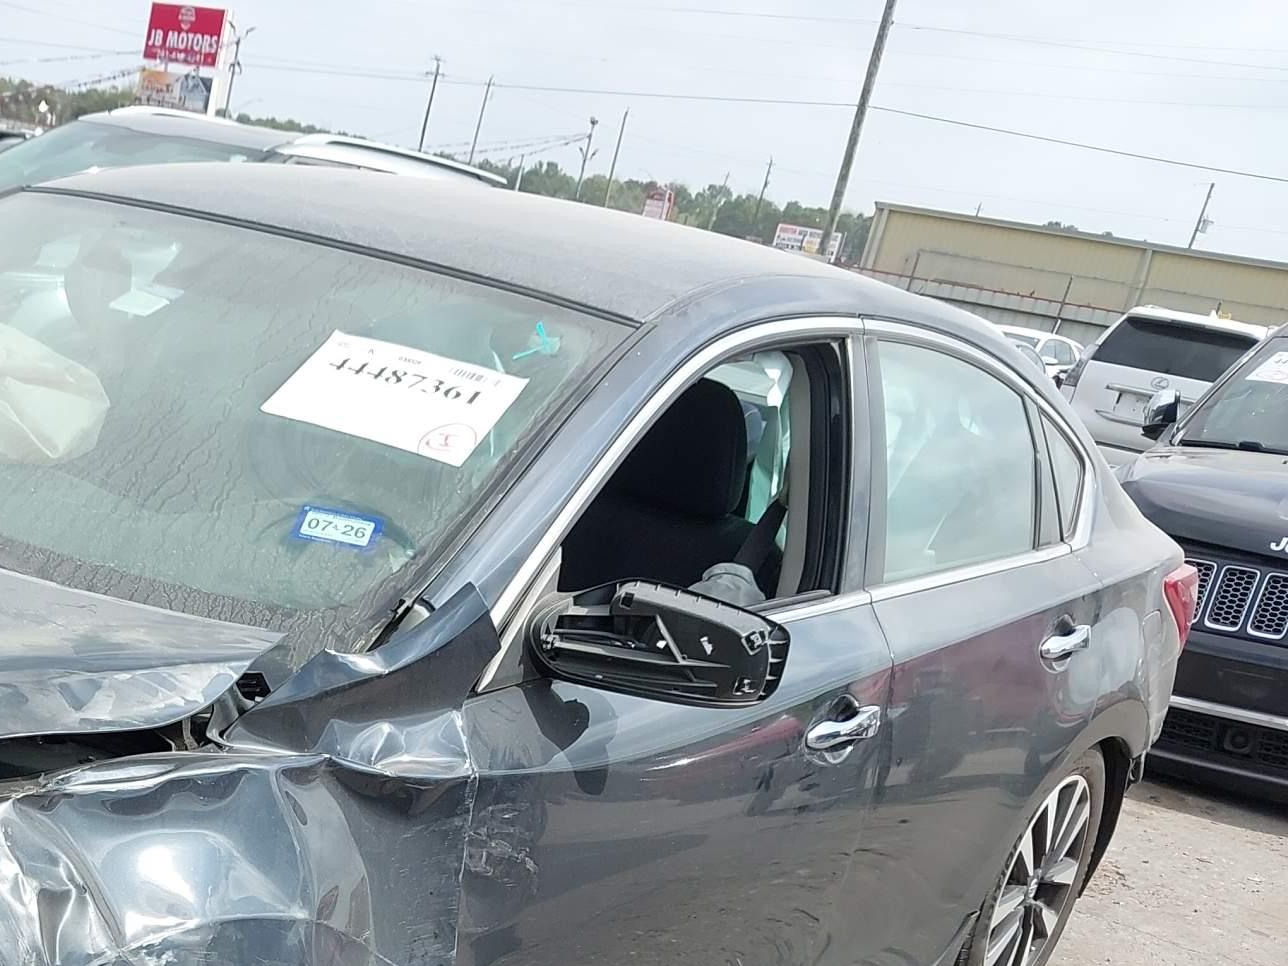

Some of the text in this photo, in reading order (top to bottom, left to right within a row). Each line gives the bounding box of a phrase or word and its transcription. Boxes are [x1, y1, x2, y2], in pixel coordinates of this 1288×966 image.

[148, 29, 218, 54] JB MOTORS
[329, 358, 481, 404] 44487361
